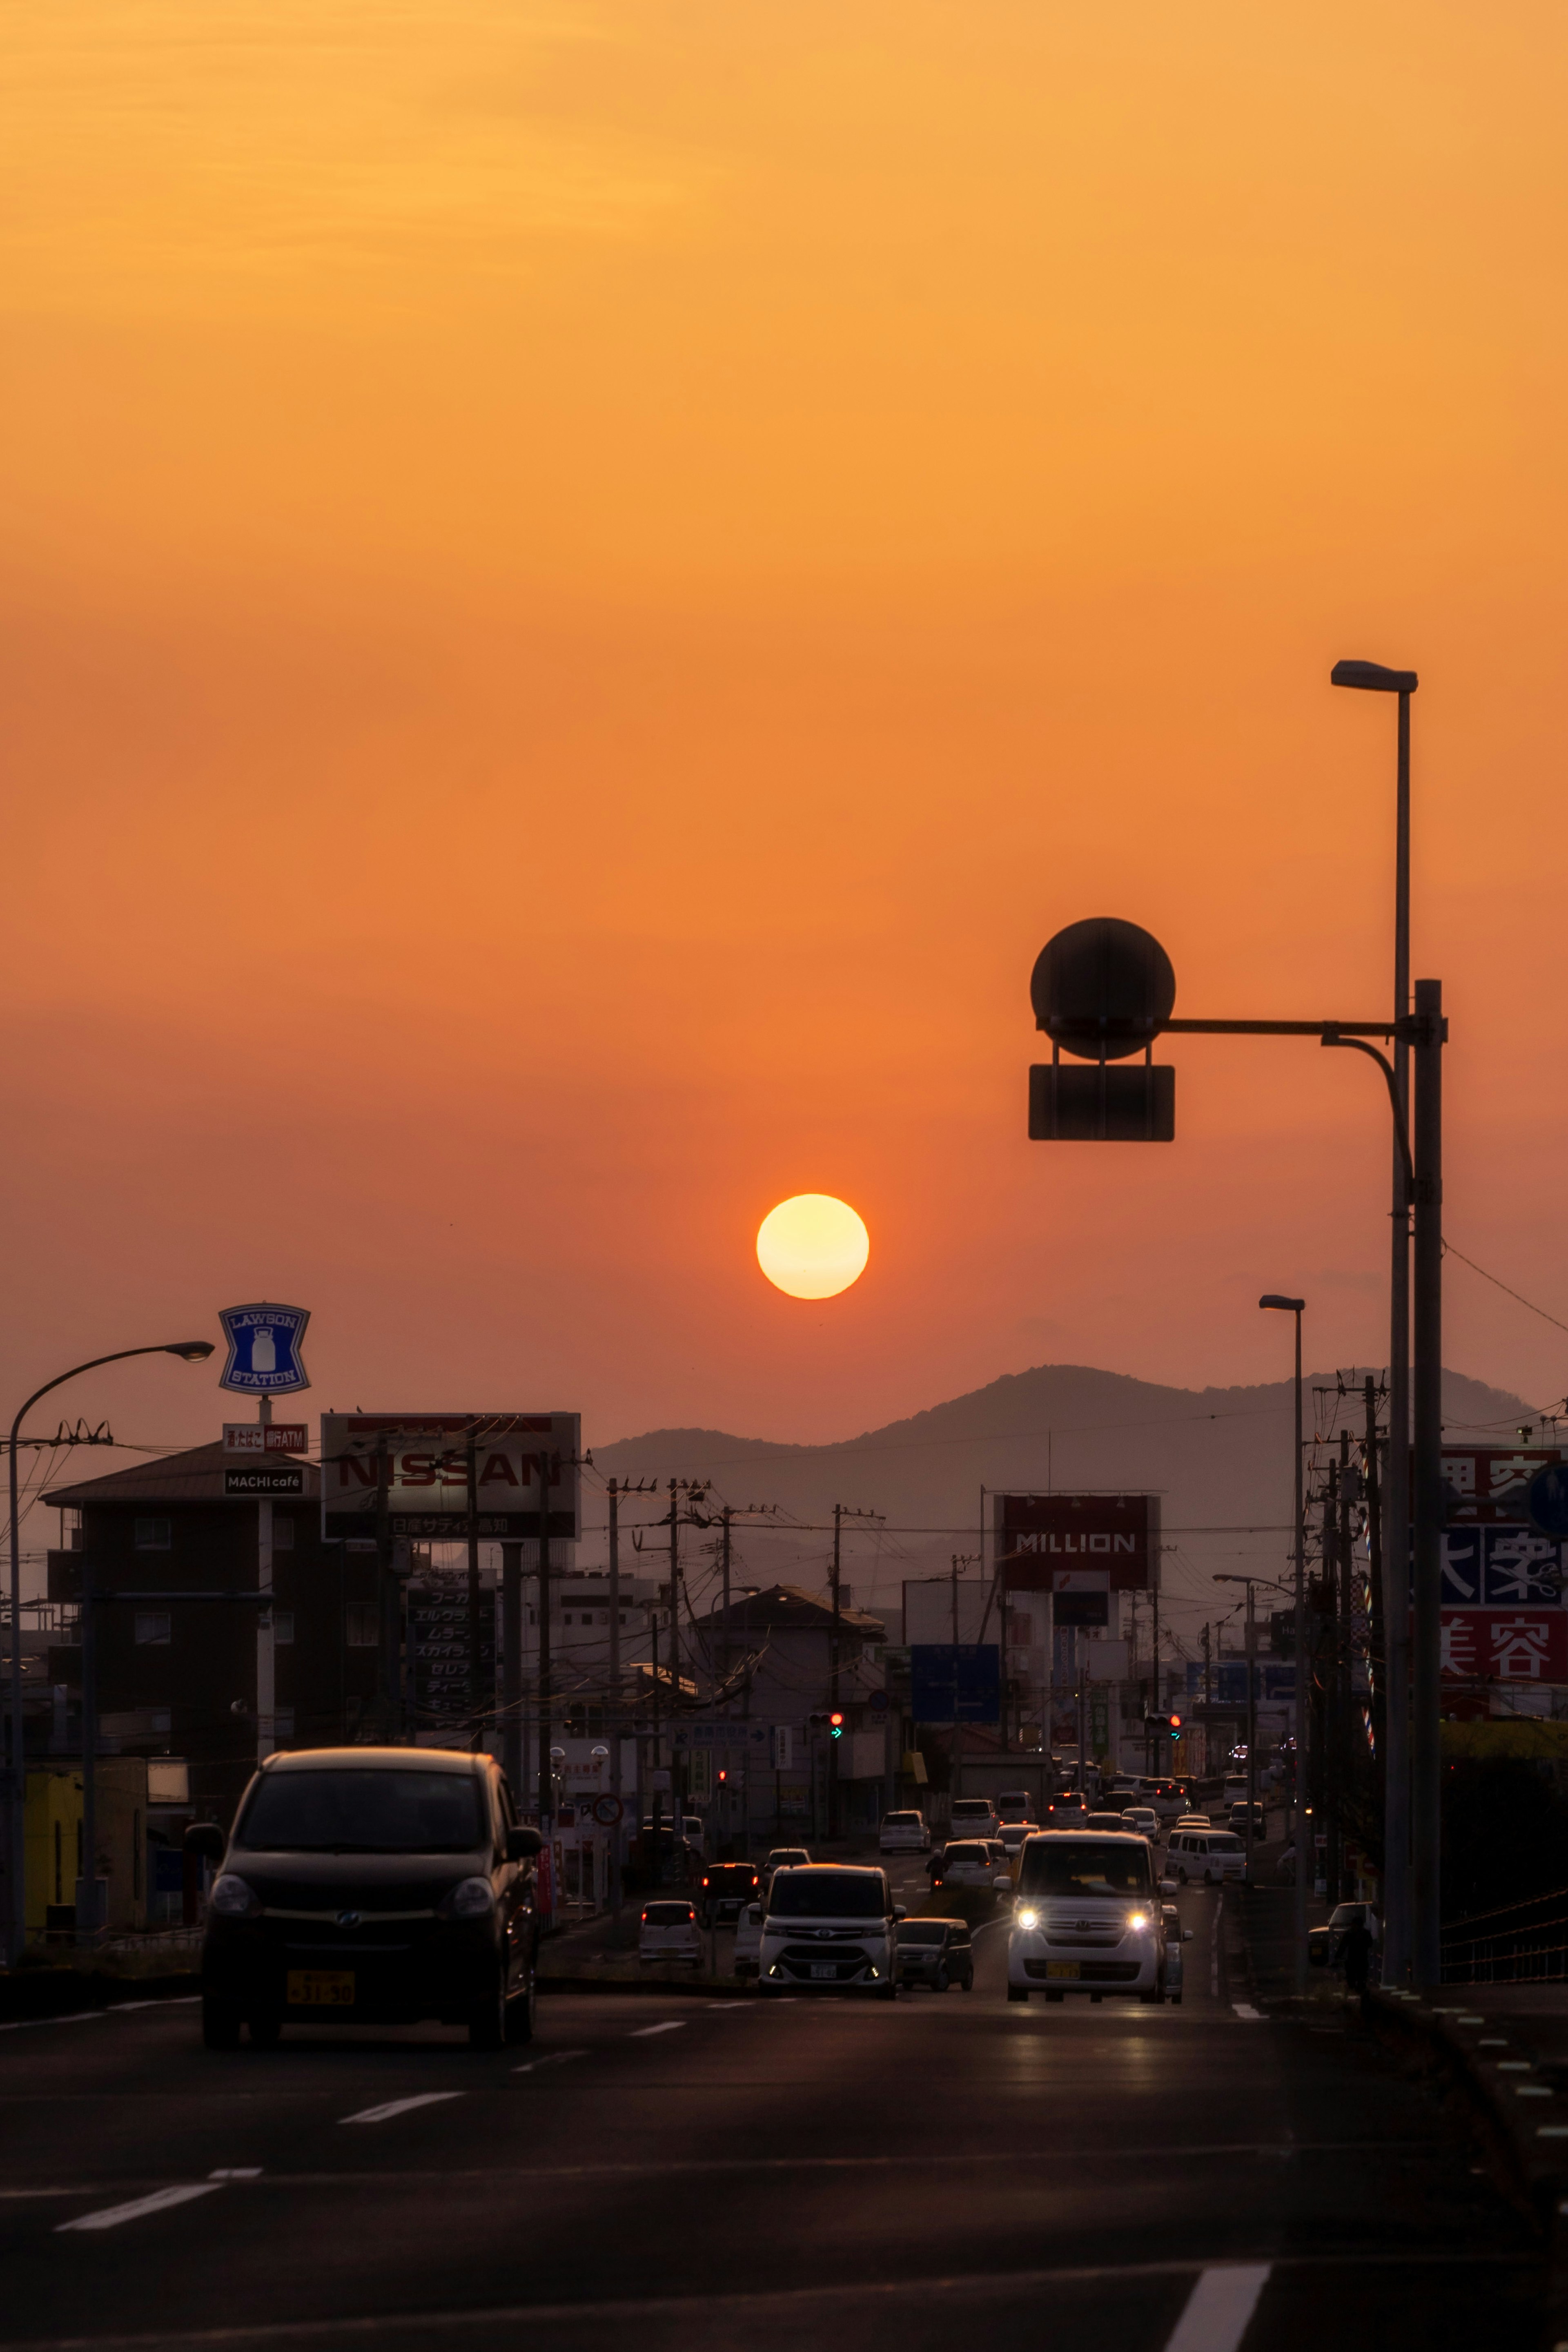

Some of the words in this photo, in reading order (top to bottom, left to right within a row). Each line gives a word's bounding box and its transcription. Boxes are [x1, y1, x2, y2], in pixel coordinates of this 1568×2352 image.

[229, 1313, 297, 1329] LAWSON
[232, 1370, 296, 1385] STATION
[340, 1454, 561, 1486] NISSAN
[228, 1476, 270, 1487] MACHI
[272, 1476, 300, 1487] café
[1016, 1534, 1135, 1552] MILLION
